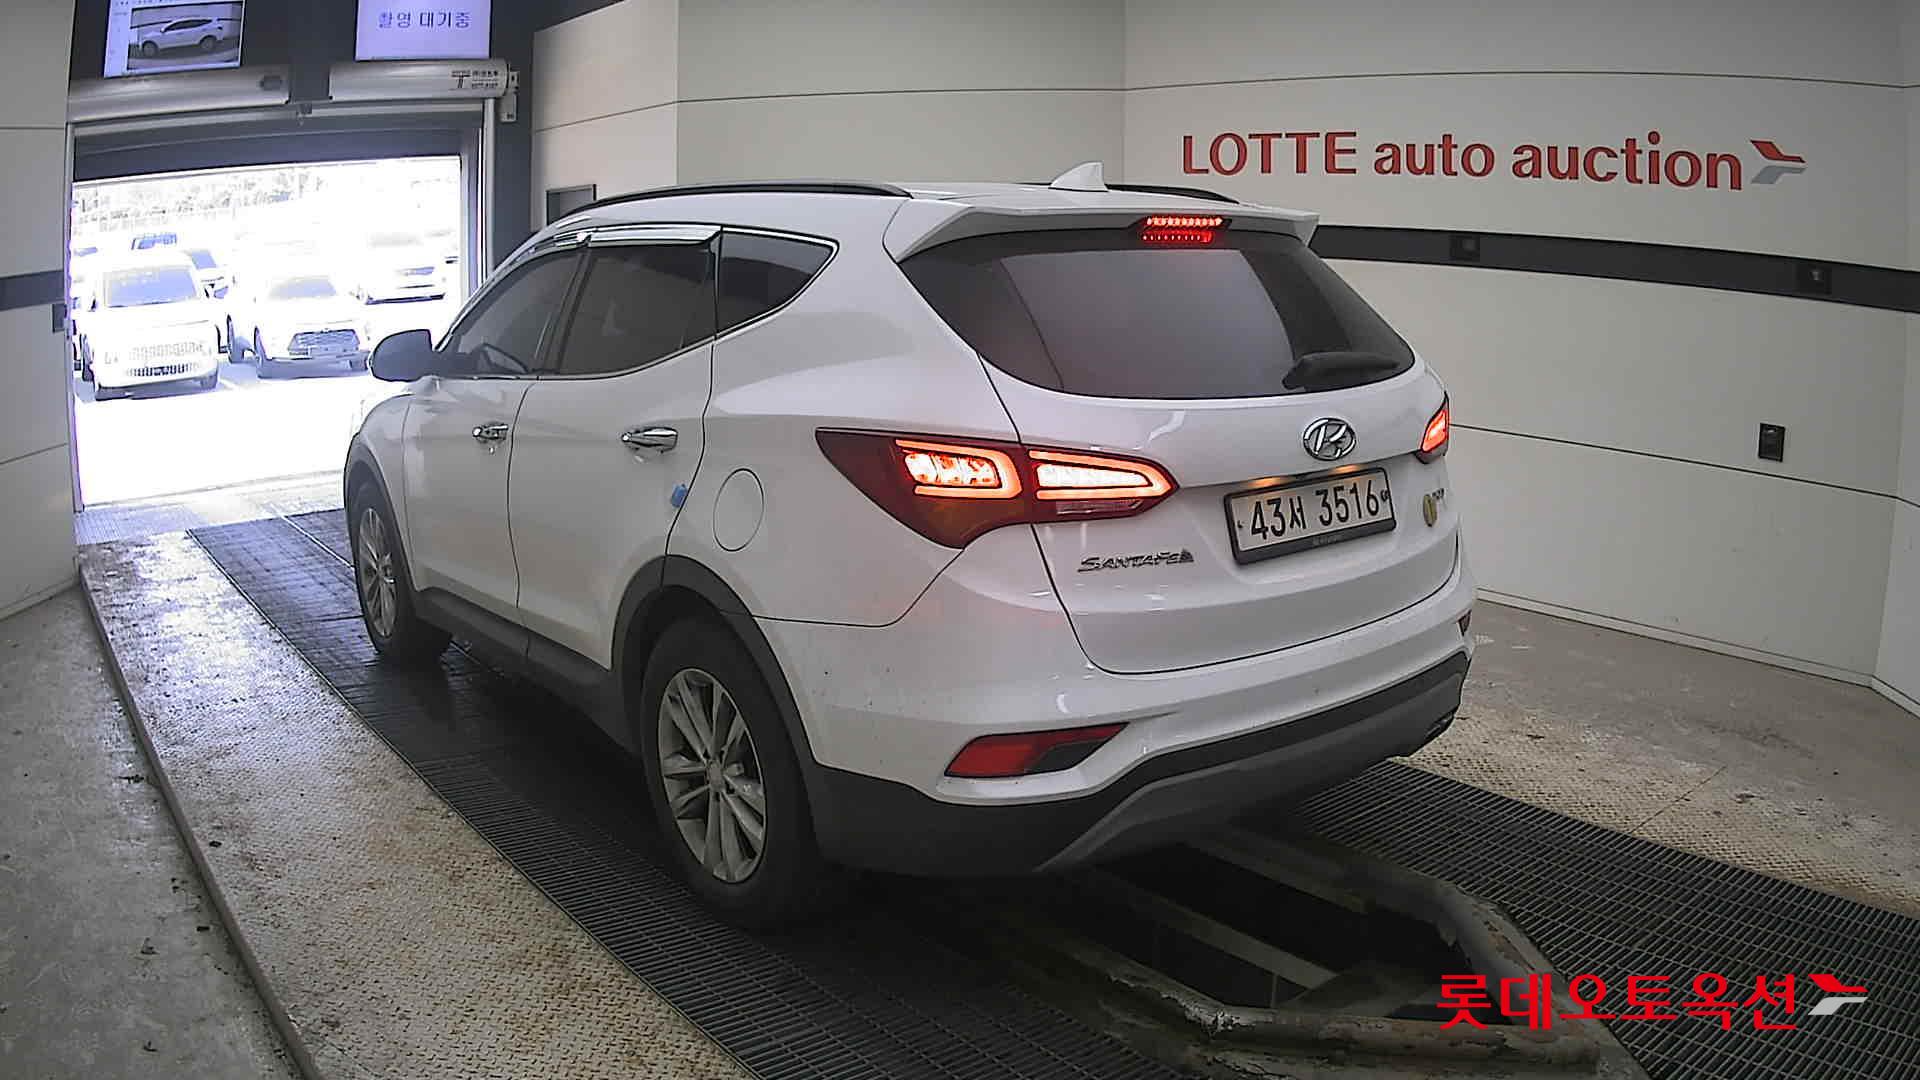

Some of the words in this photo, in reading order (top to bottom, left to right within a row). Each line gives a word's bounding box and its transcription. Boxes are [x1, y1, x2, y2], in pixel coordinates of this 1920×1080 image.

[419, 10, 472, 29] 대기중
[1183, 131, 1358, 176] LOTTE
[1373, 132, 1495, 178] auto
[1512, 130, 1743, 190] auction
[1251, 495, 1307, 540] 43서
[1315, 479, 1379, 527] 3516
